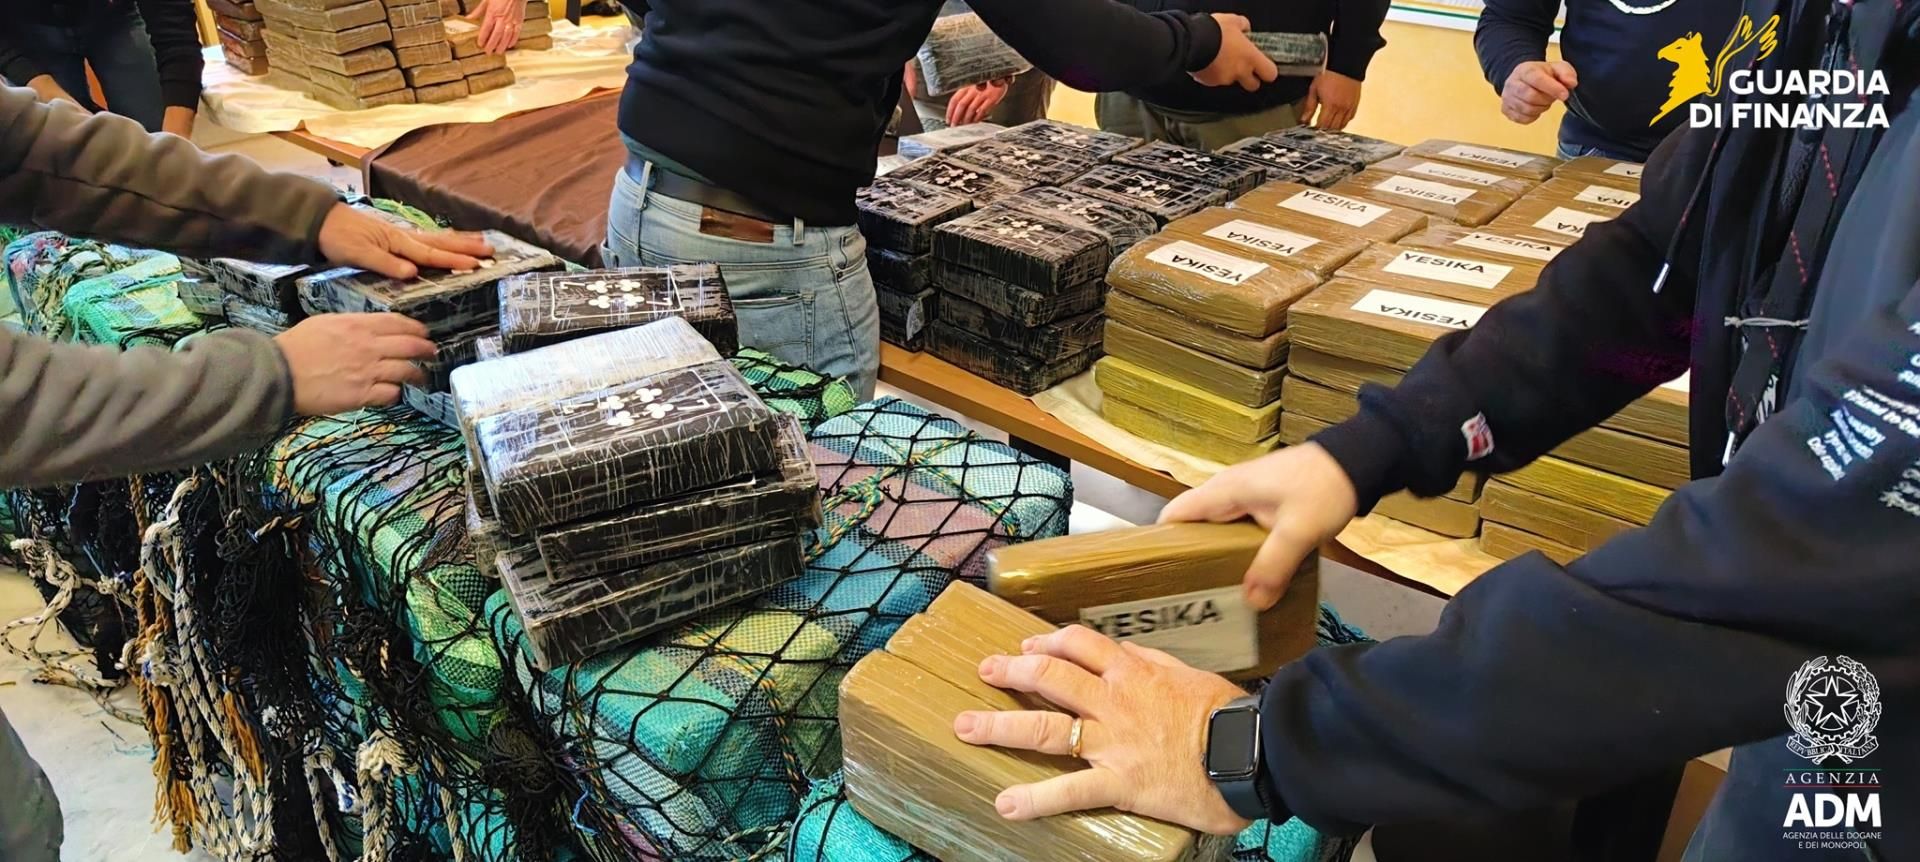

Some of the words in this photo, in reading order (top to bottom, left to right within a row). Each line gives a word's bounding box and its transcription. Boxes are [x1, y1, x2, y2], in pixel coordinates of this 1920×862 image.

[1459, 151, 1518, 166] YESIKA
[1302, 190, 1367, 212] YESIKA
[1395, 185, 1457, 203] YESIKA
[1227, 231, 1296, 254] YESIKA
[1474, 234, 1551, 251] YESIKA
[1172, 254, 1243, 282] YESIKA
[1403, 253, 1485, 273] YESIKA
[1380, 304, 1468, 328] YESIKA
[1087, 599, 1222, 638] YESIKA
